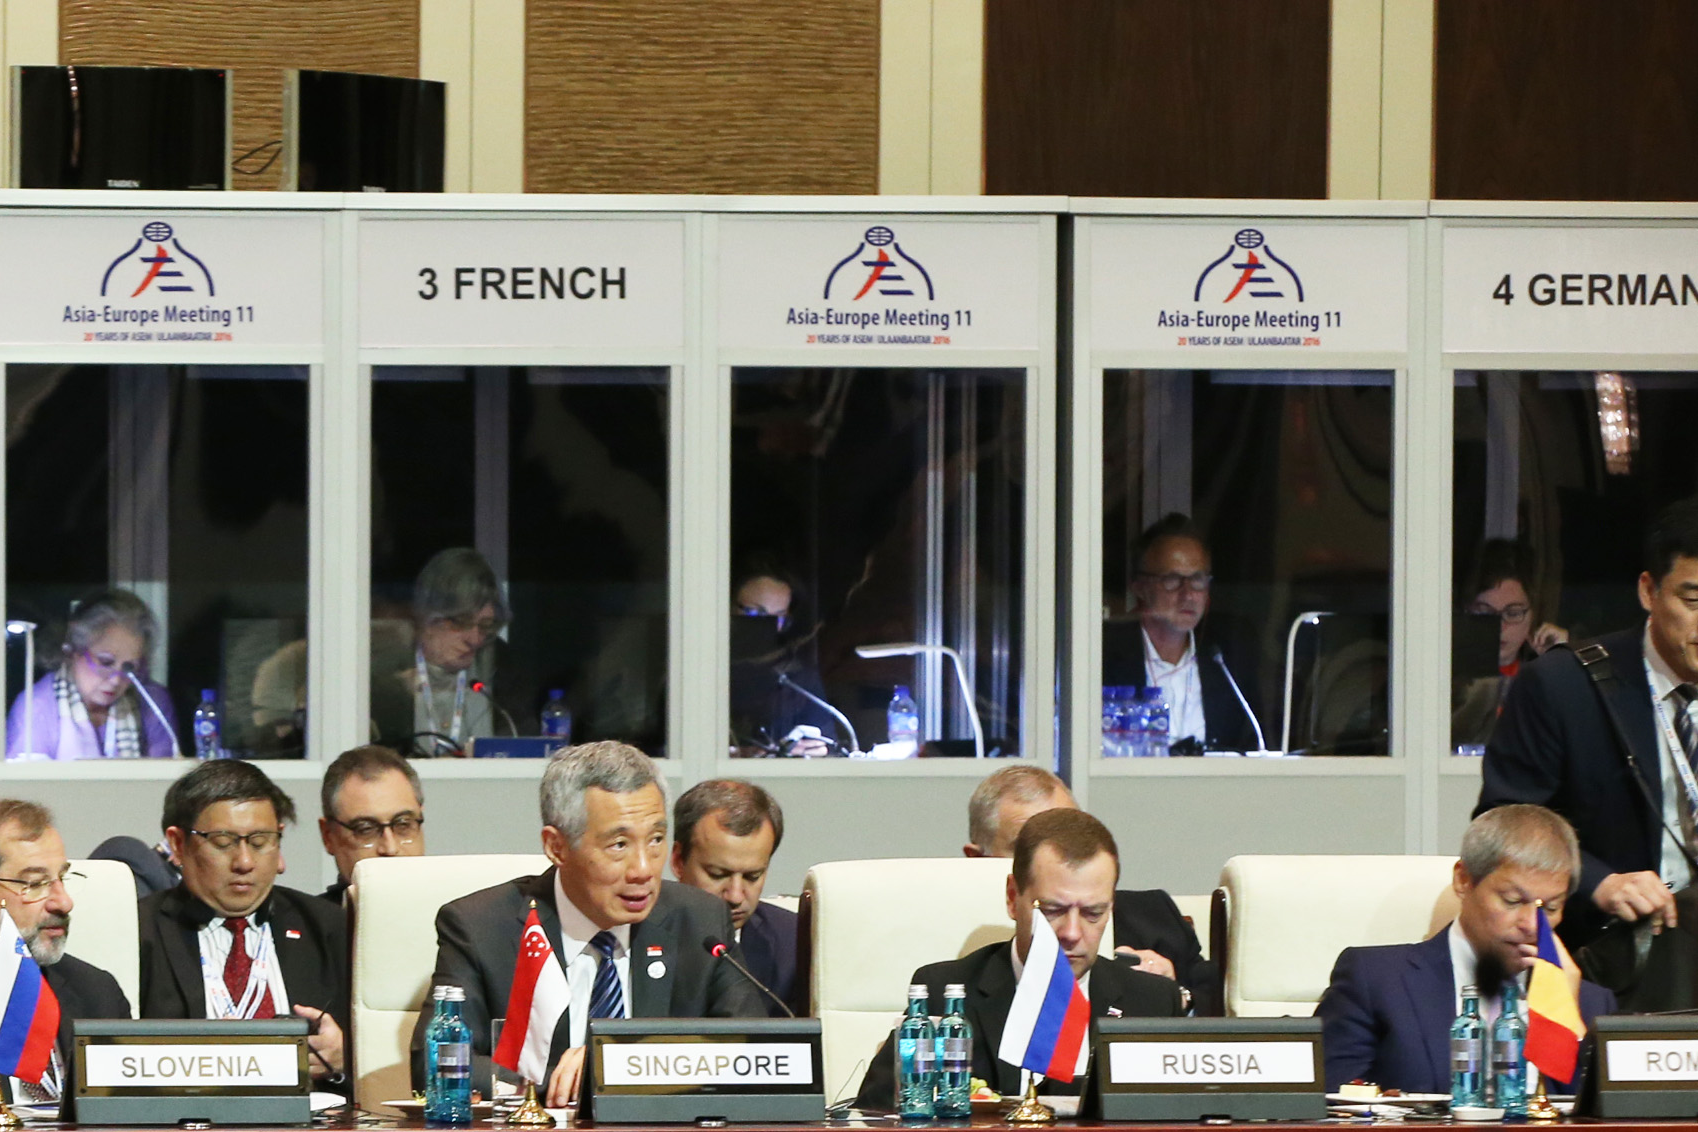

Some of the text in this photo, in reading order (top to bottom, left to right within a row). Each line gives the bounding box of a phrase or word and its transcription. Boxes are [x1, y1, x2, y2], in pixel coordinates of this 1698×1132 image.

[418, 266, 626, 301] 3 FRENCH
[1492, 273, 1698, 307] 4 GERMAN
[62, 304, 254, 328] Asia-Europe Meeting 11
[786, 307, 972, 331] Asia-Europe Meeting 11
[1157, 309, 1341, 333] Asia-Europe Meeting 11
[120, 1055, 263, 1079] SLOVENIA
[626, 1054, 791, 1077] SINGAPORE
[1162, 1053, 1262, 1076] RUSSIA
